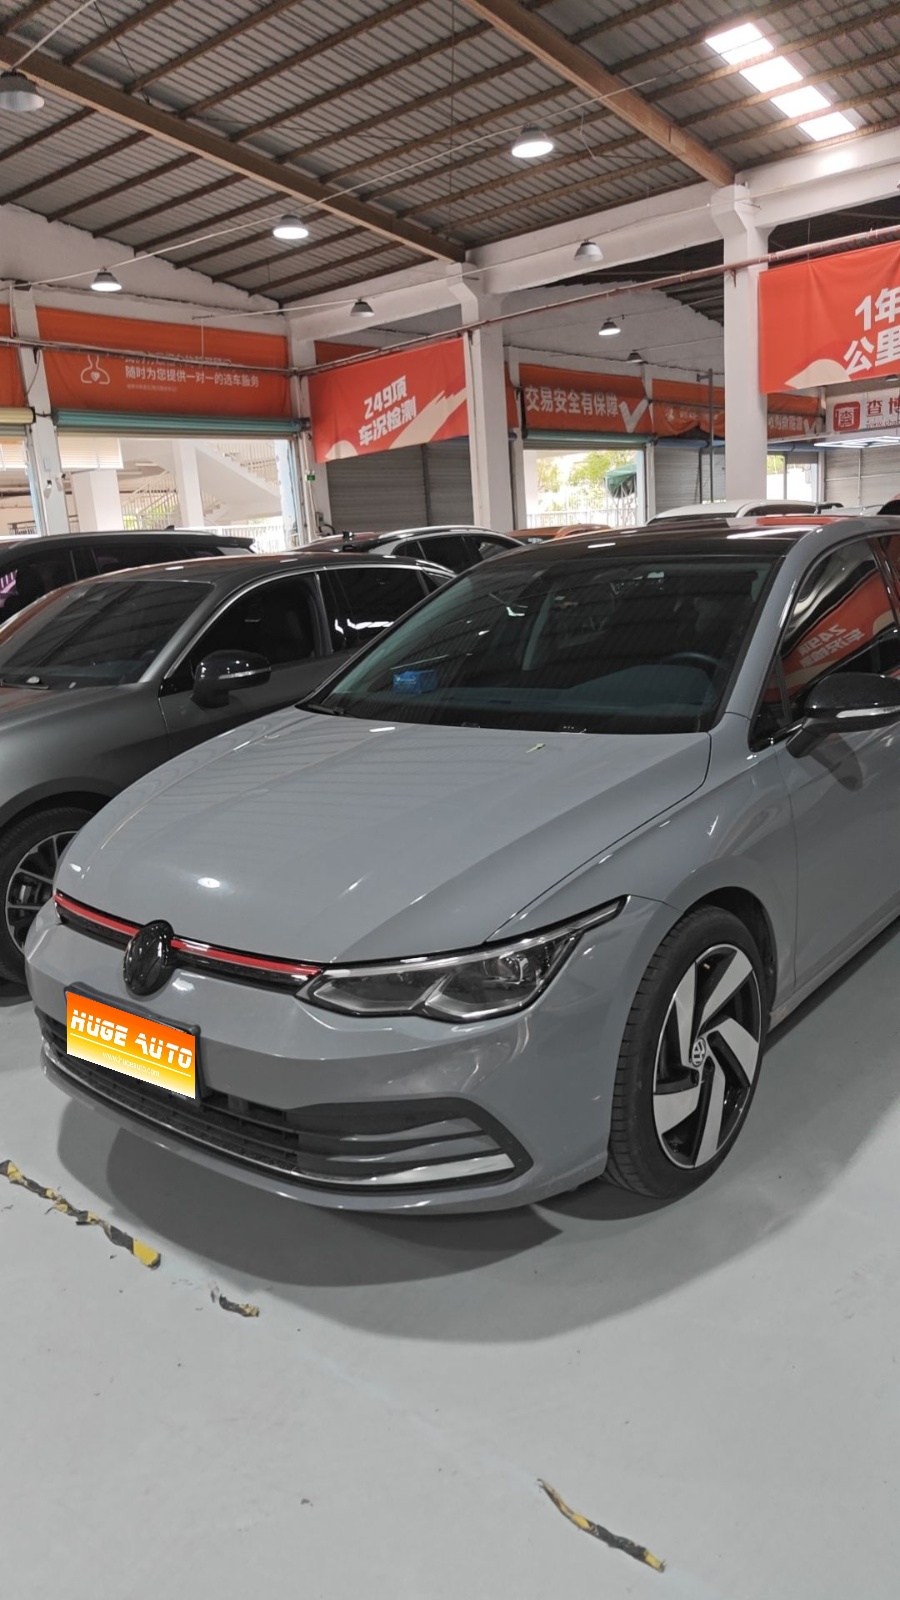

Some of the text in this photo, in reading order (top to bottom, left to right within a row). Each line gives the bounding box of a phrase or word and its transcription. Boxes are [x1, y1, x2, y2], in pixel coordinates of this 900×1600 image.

[855, 286, 900, 331] 1年
[843, 325, 900, 376] 公里
[124, 365, 259, 388] 随时为您提供一对一的选车服务
[364, 374, 407, 420] 249项
[358, 395, 417, 446] 车况检测
[525, 385, 619, 417] 交易安全有保障
